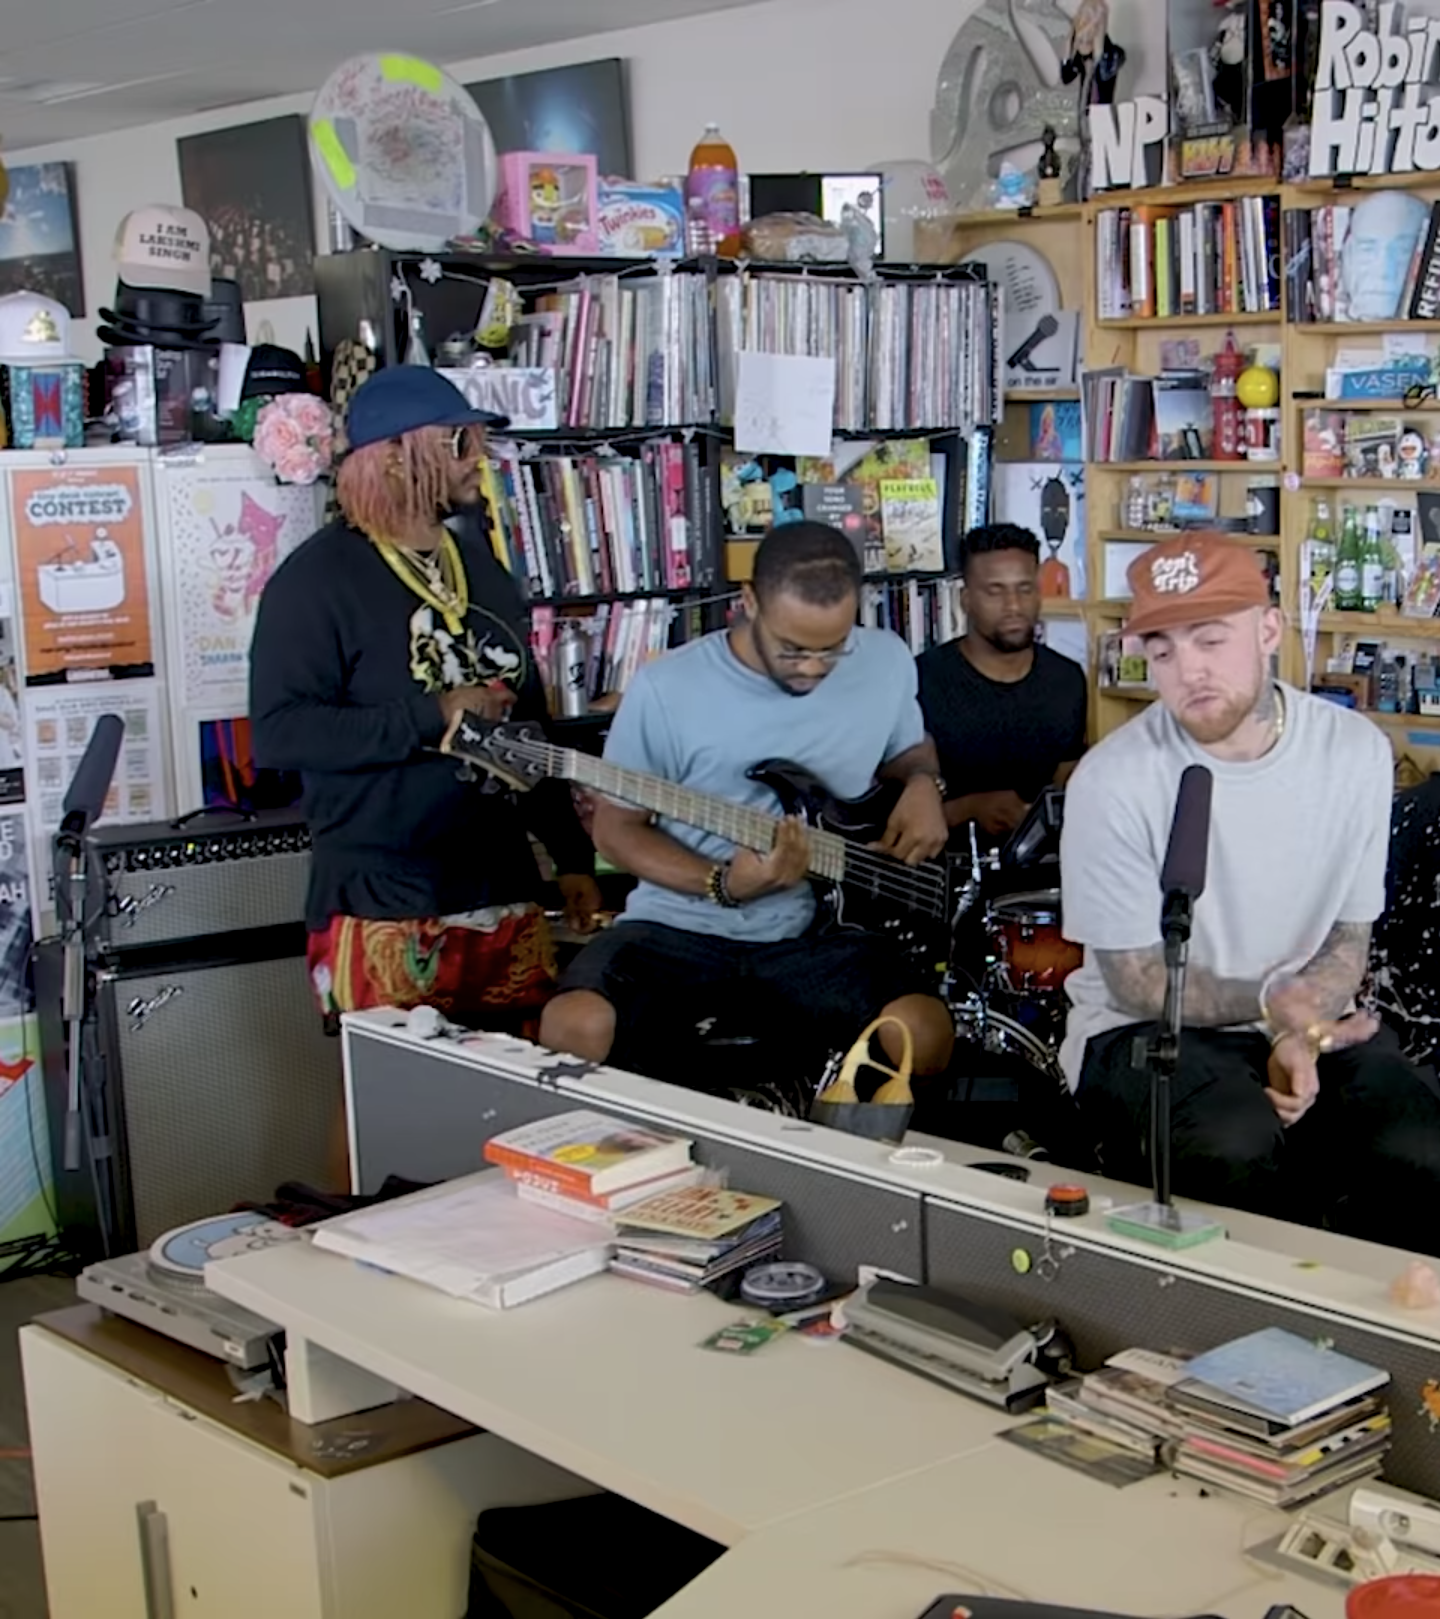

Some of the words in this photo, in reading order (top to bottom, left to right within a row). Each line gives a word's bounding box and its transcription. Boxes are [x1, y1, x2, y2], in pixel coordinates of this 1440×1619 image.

[1090, 95, 1175, 190] NP
[601, 206, 657, 235] Twinkies
[156, 223, 163, 234] I
[166, 225, 188, 237] AM
[139, 234, 200, 252] LAKSHMI
[149, 247, 191, 262] SINGH
[1007, 376, 1022, 387] on
[1025, 375, 1042, 387] the
[1045, 374, 1059, 386] air
[30, 498, 126, 518] CONTEST
